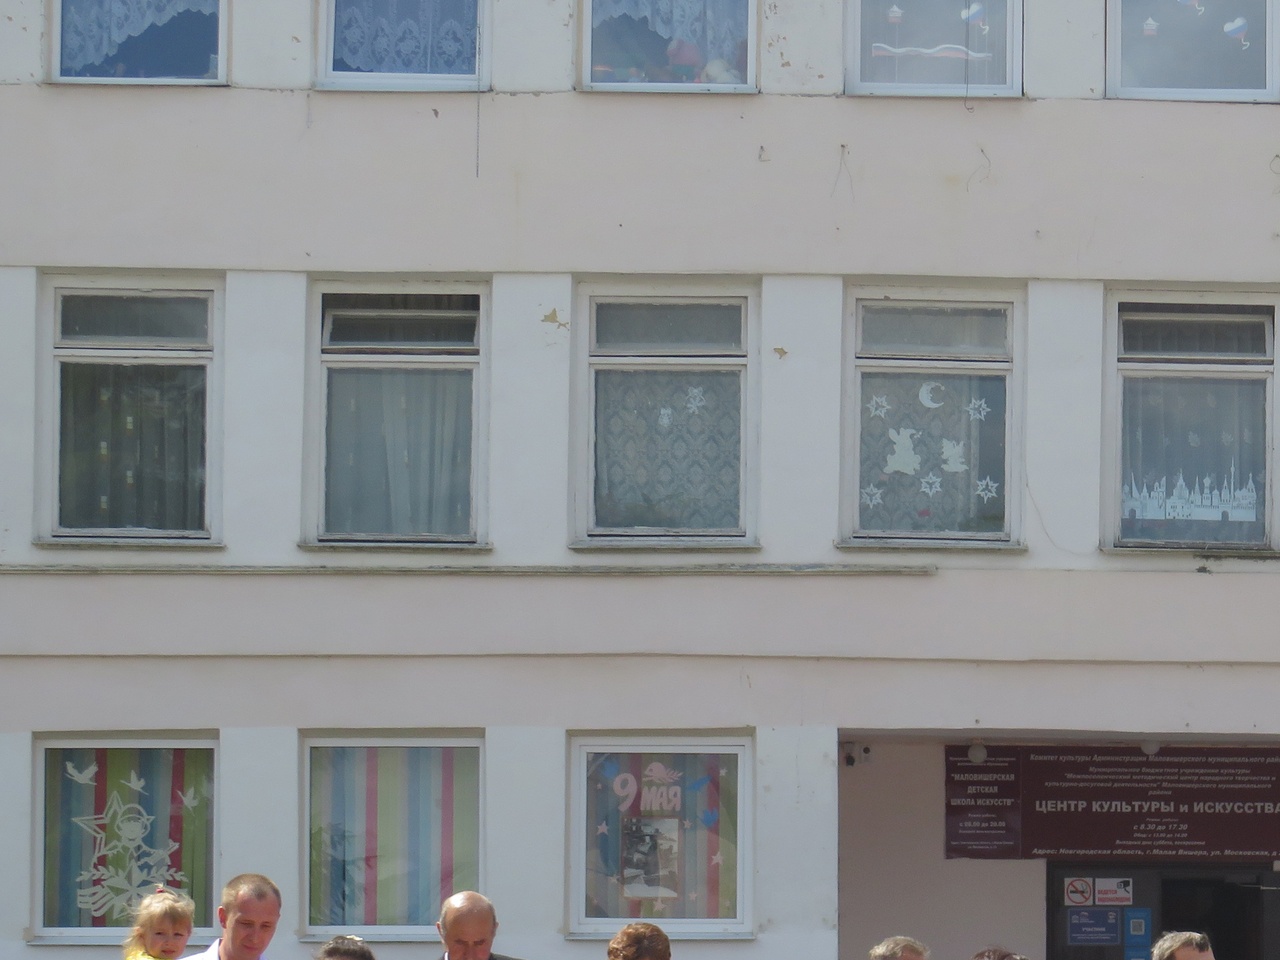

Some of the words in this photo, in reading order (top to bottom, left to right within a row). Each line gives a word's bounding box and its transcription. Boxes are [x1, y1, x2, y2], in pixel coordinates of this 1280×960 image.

[1030, 754, 1058, 762] Комитет
[1092, 754, 1147, 763] Администрации
[1148, 755, 1206, 763] Маловишерского
[1207, 756, 1265, 764] муниципального
[951, 773, 1015, 781] "МАЛОВИШЕРСКАЯ
[613, 773, 638, 812] 9
[640, 785, 682, 812] МАЯ
[967, 785, 998, 794] ДЕТСКАЯ
[950, 798, 975, 806] ШКОЛА
[976, 798, 1015, 806] ИСКУССТВ"
[1035, 800, 1087, 813] ЦЕНТР
[1092, 801, 1174, 813] КУЛЬТУРЫ
[1179, 804, 1188, 813] и
[1112, 848, 1144, 856] область,
[1178, 849, 1209, 857] Вишера,
[1223, 849, 1270, 857] Московская,
